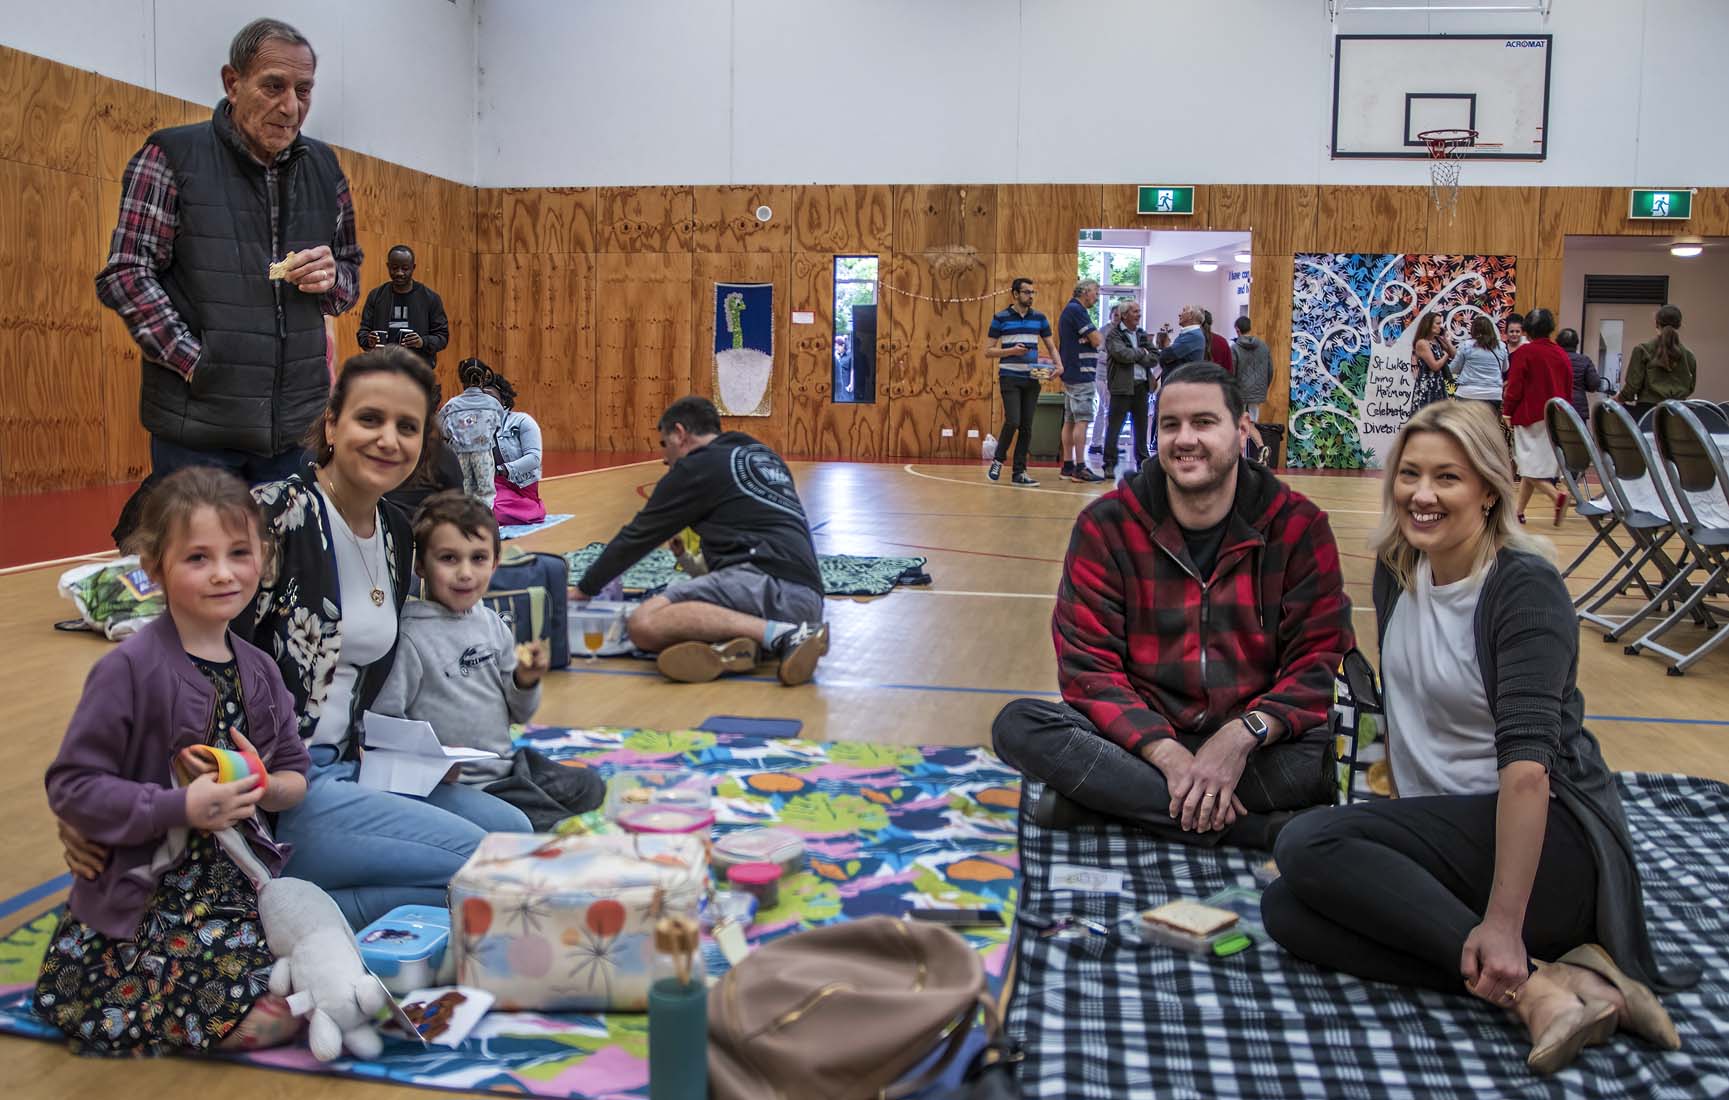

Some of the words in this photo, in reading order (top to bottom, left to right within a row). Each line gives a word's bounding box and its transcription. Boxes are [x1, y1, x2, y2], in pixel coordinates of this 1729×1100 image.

[1372, 355, 1384, 370] St
[1386, 356, 1410, 372] Lukes
[1369, 372, 1394, 388] Living
[1400, 375, 1410, 386] In
[1376, 386, 1411, 406] Harmony
[1363, 422, 1402, 434] Diversit
